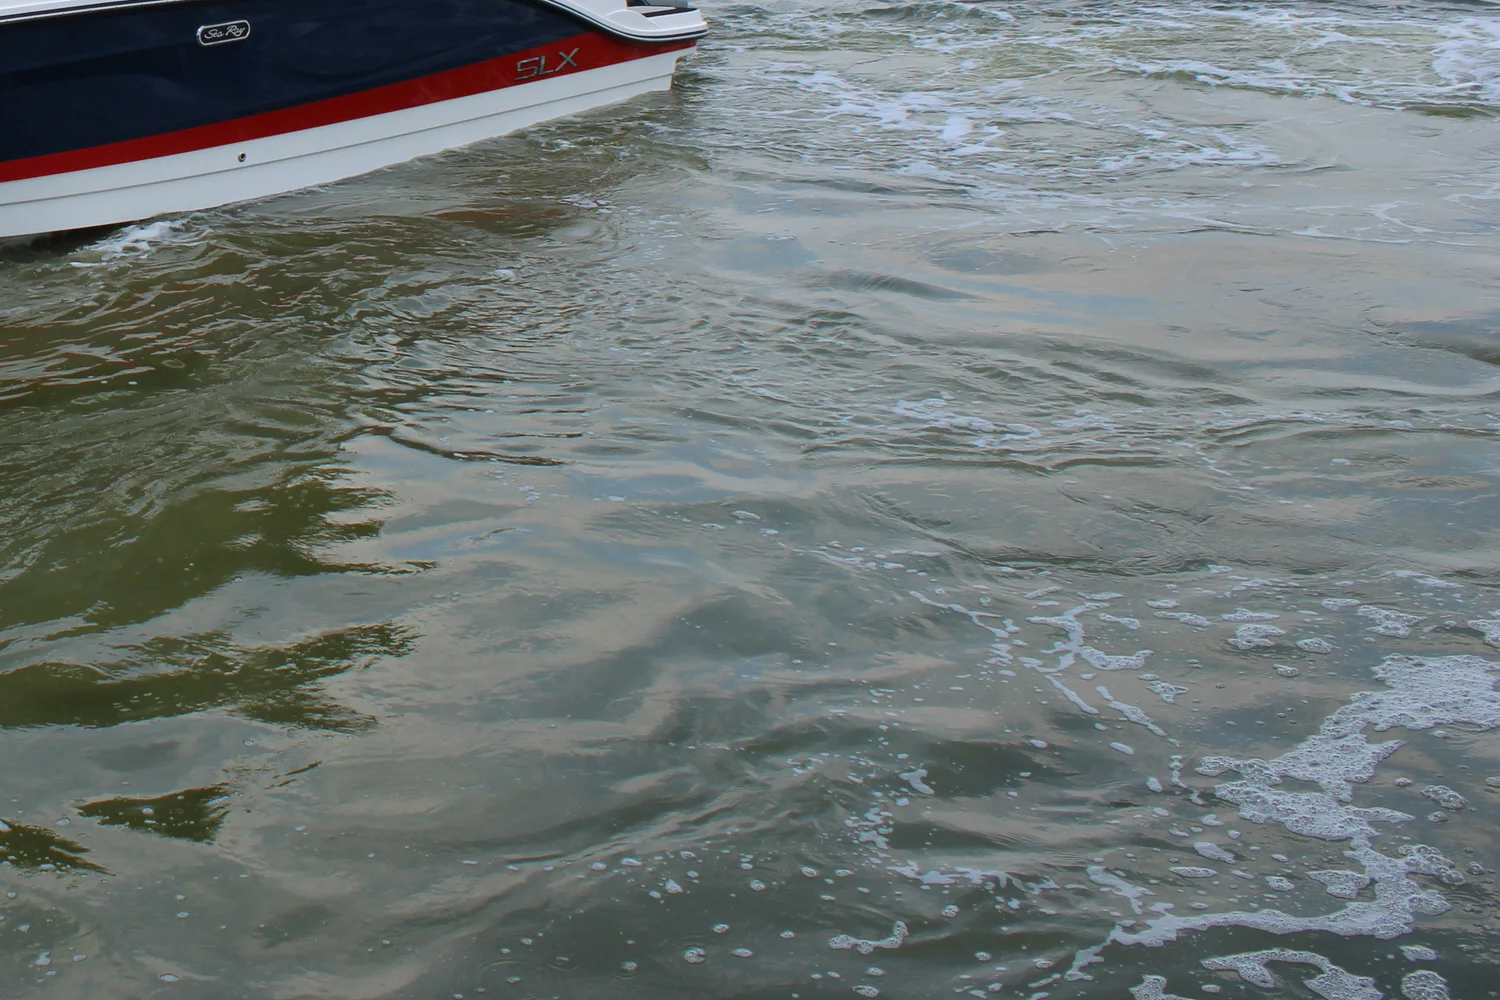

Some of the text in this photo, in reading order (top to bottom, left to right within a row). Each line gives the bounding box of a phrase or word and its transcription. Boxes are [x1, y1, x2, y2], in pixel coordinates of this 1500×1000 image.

[203, 24, 246, 39] Sea Ray
[514, 47, 580, 80] SLX
